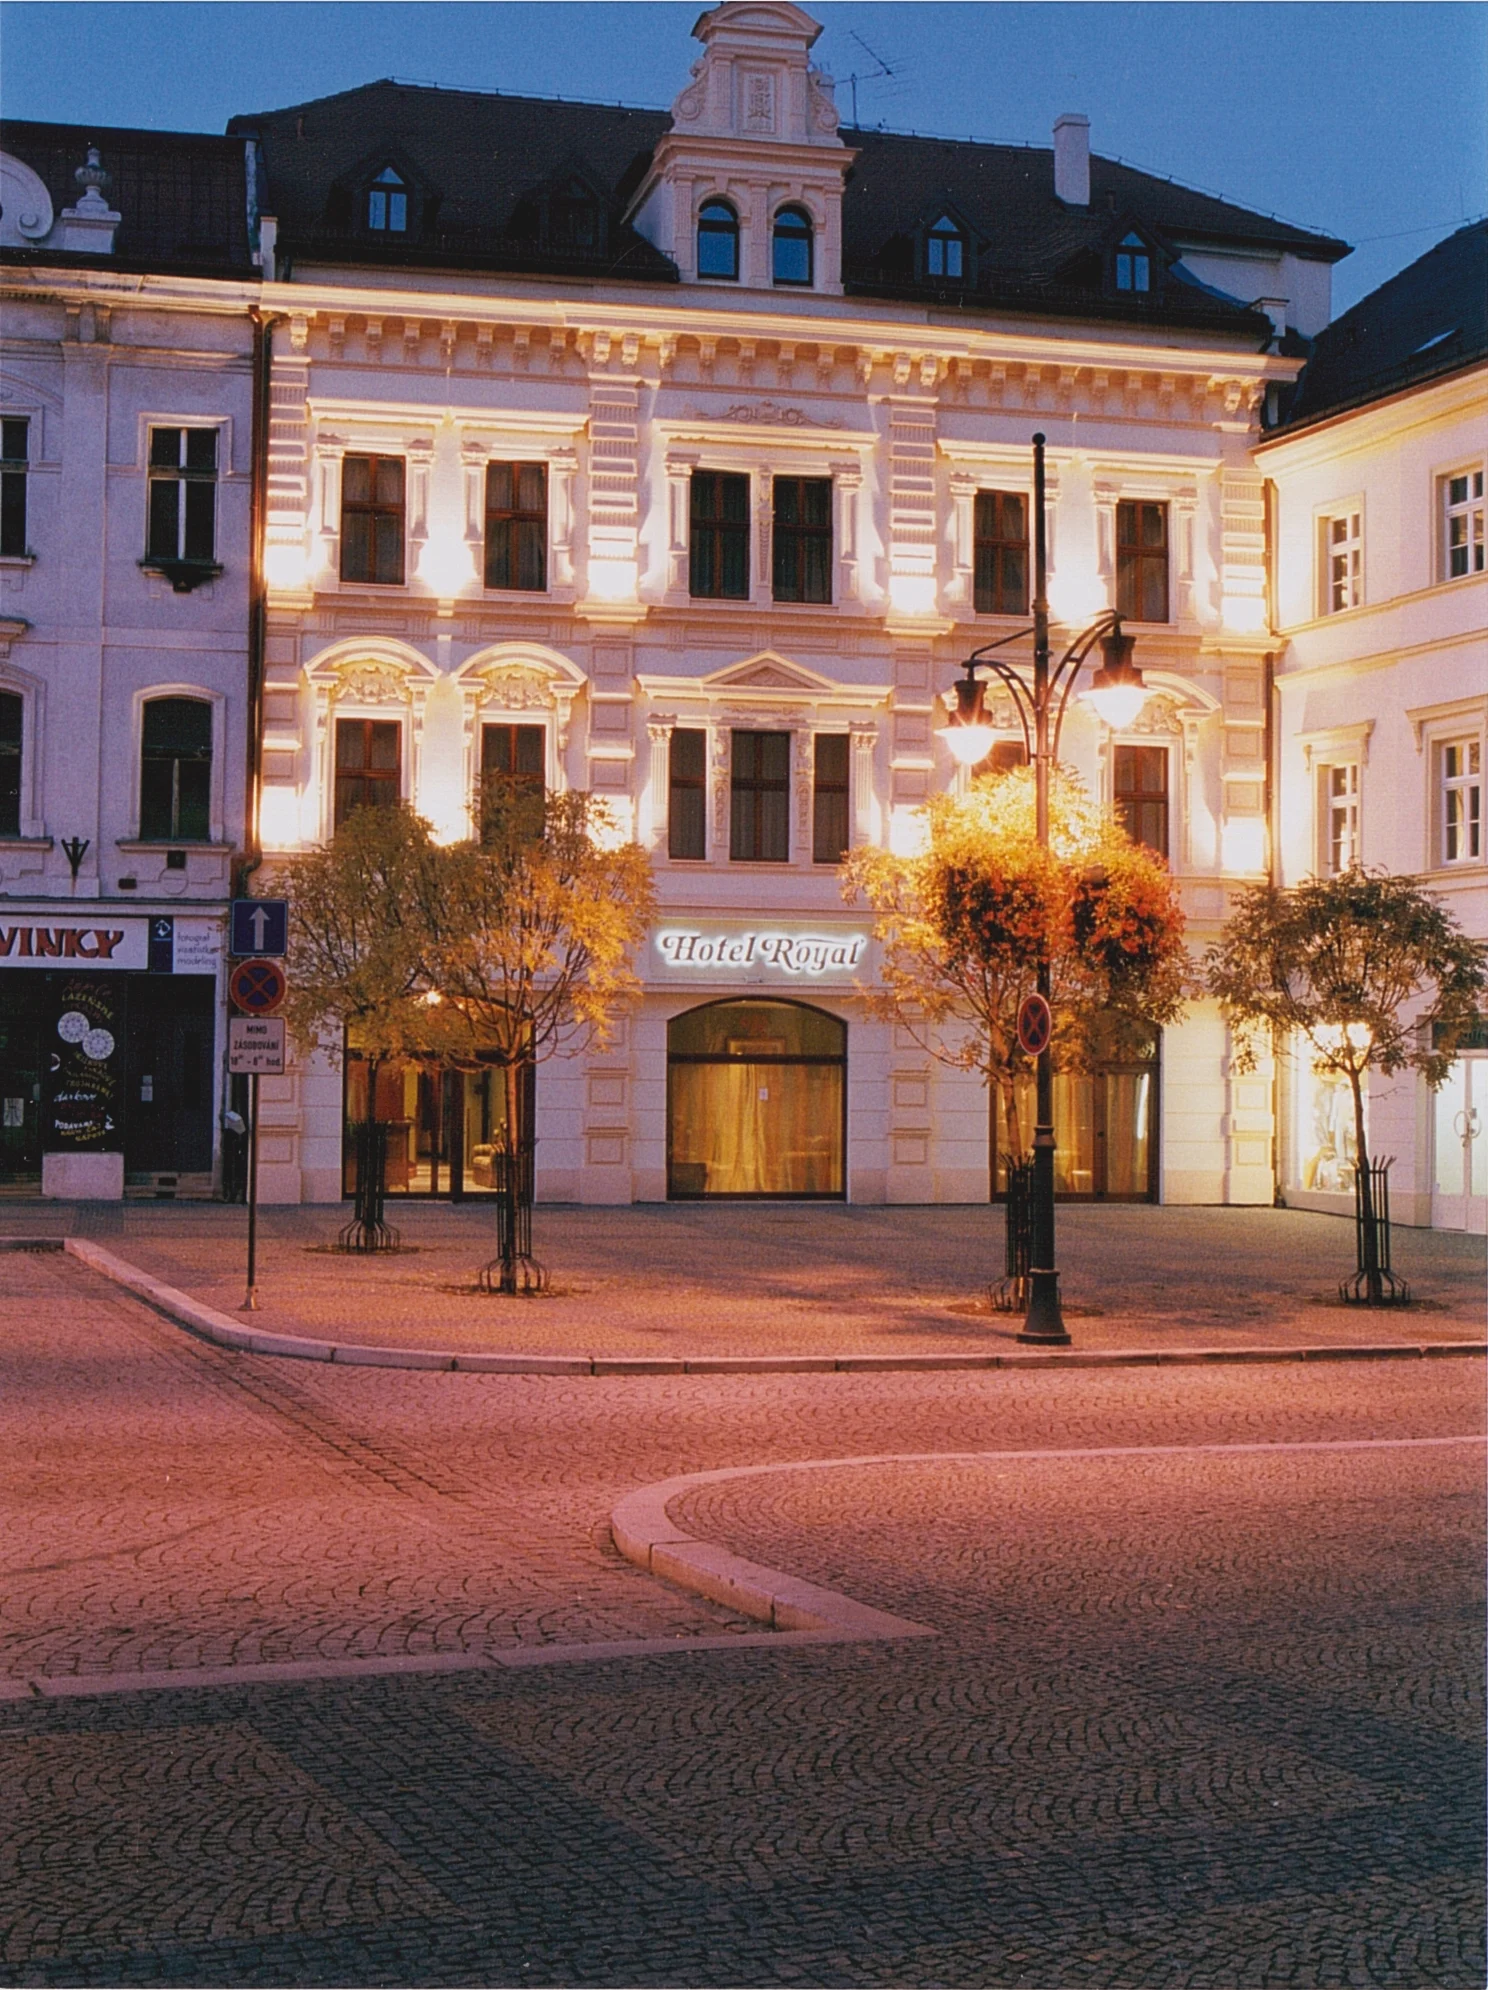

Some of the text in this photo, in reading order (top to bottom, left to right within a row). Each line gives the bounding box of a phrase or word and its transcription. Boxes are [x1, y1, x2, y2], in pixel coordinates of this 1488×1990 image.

[662, 935, 865, 970] Hotel Royal
[246, 1025, 268, 1035] MIMO
